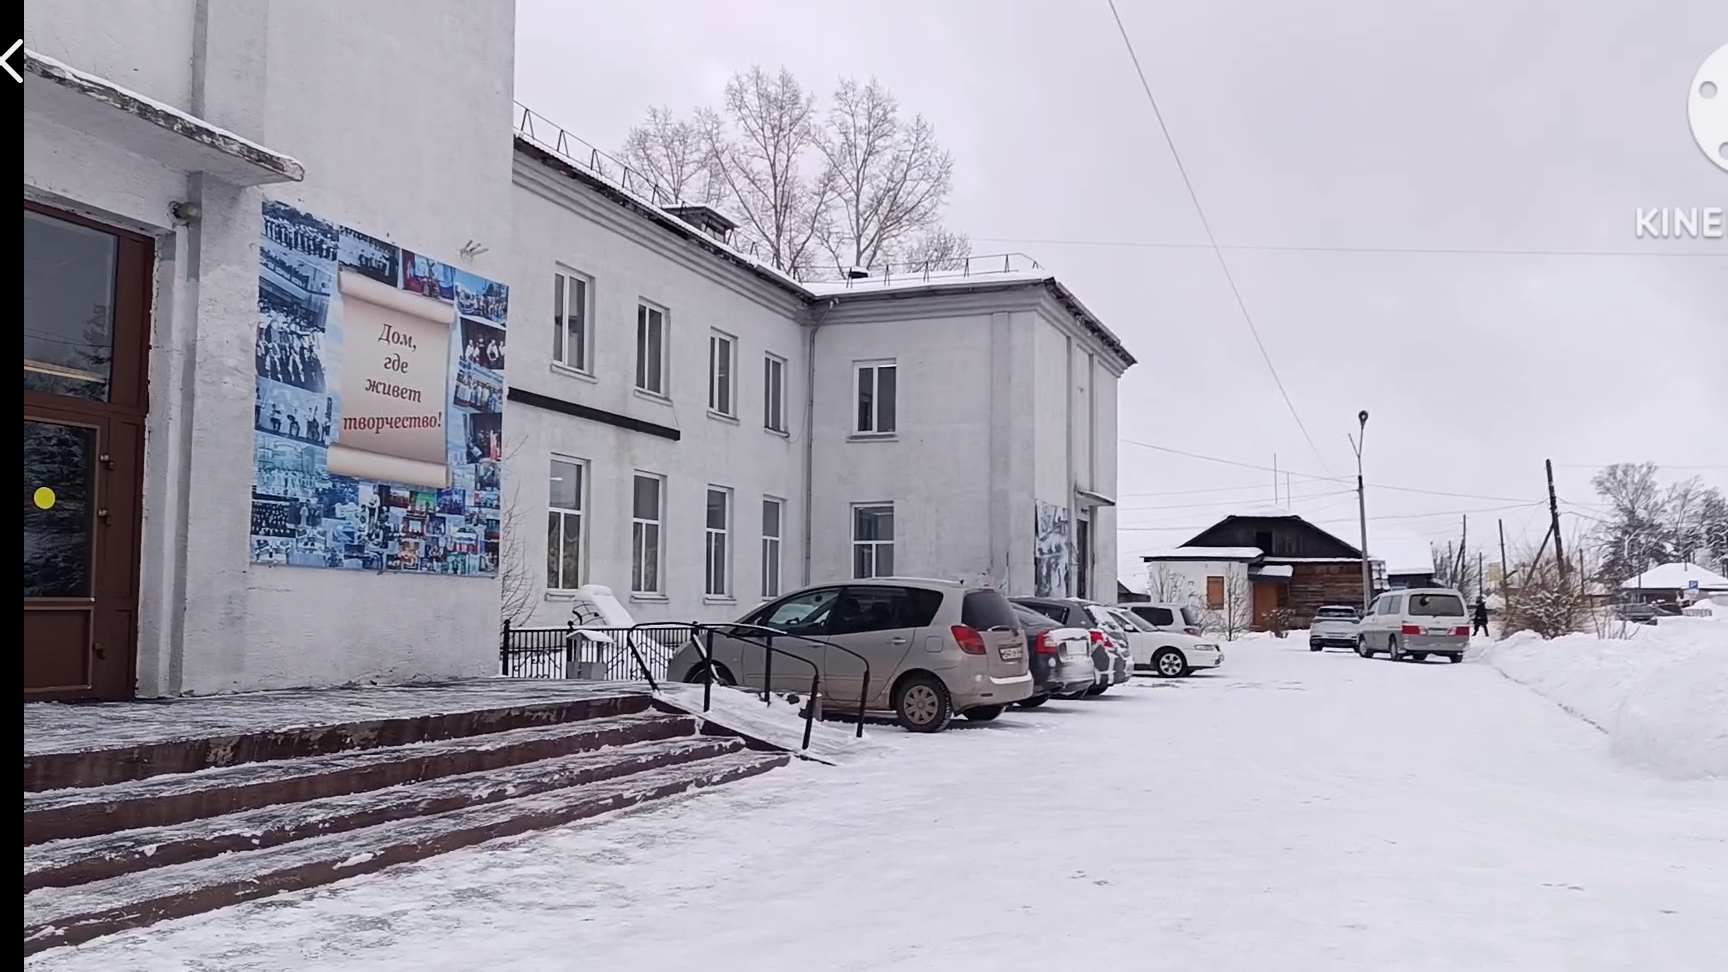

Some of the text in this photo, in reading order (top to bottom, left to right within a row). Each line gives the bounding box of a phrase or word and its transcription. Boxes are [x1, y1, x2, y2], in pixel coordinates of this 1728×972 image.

[378, 323, 417, 352] Дом,
[383, 353, 409, 374] где
[365, 378, 422, 403] живет
[343, 411, 442, 434] творчество!
